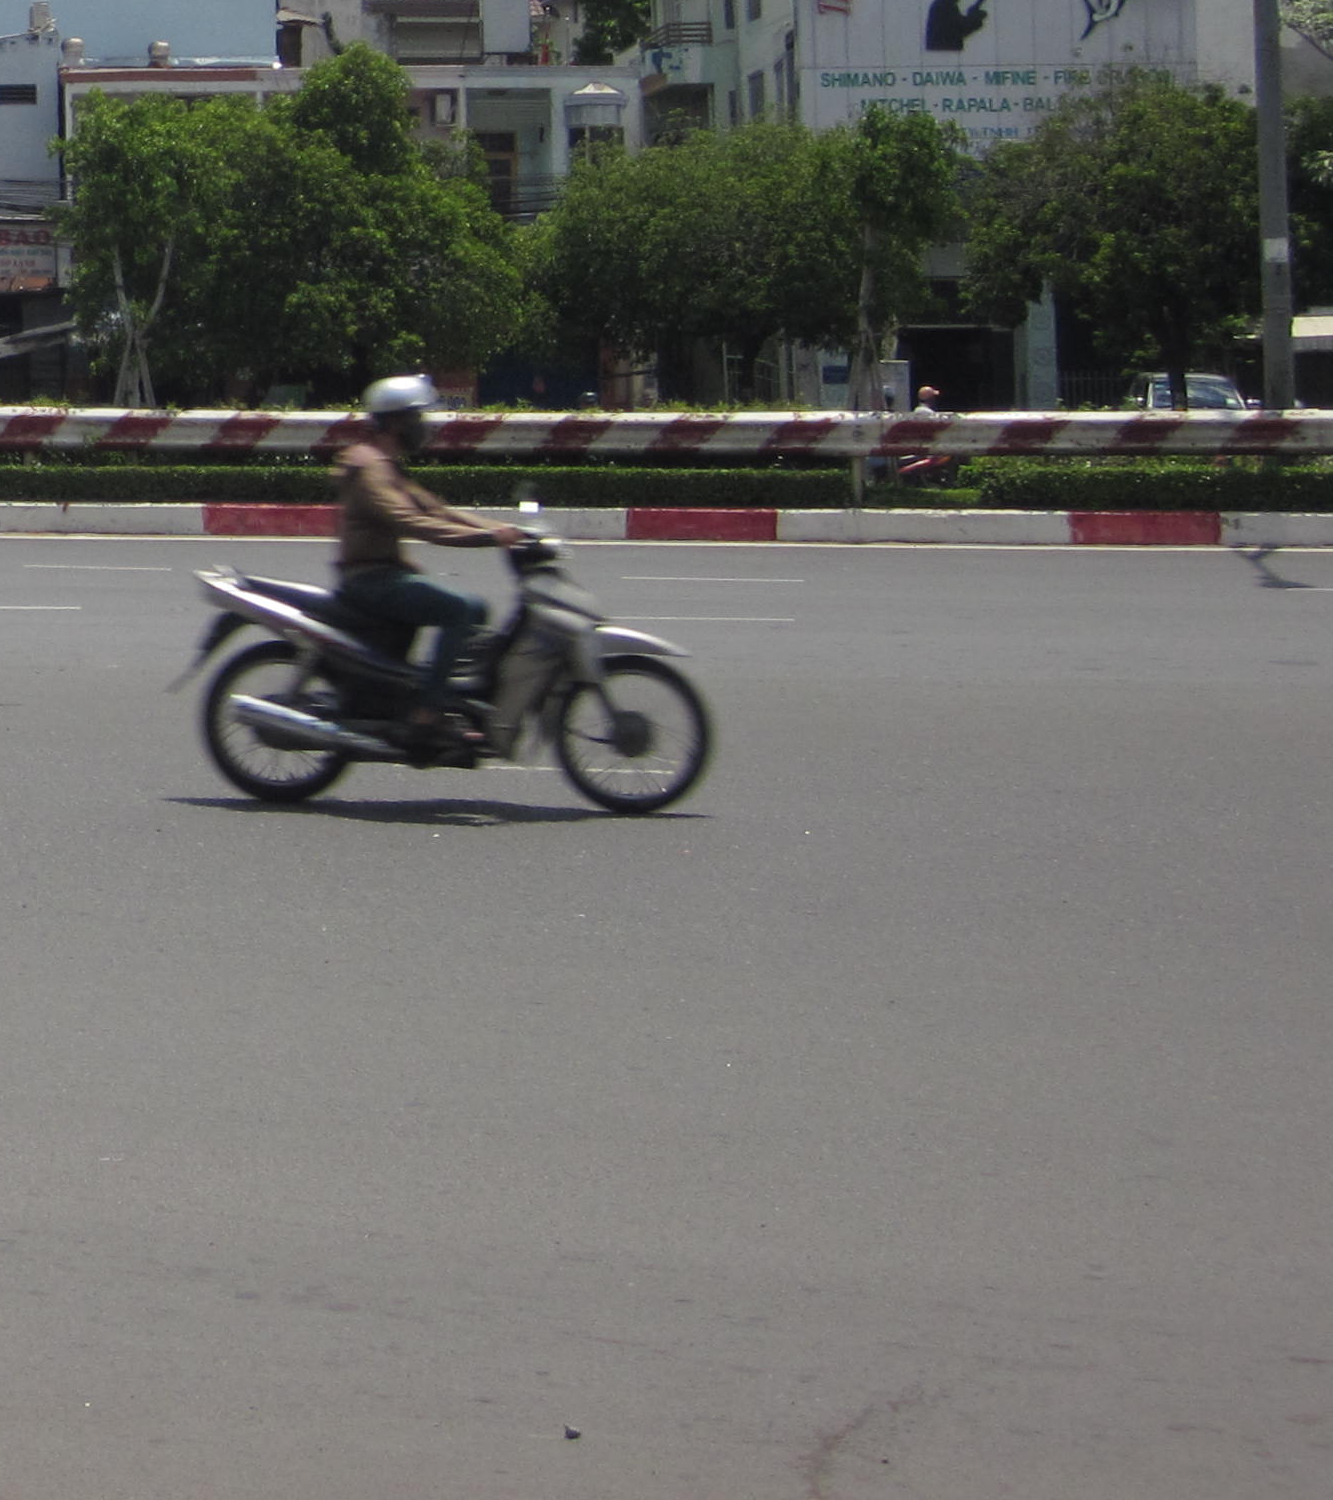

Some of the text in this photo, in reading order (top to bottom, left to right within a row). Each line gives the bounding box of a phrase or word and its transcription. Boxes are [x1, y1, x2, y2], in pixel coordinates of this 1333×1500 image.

[820, 72, 897, 88] SHIMANO
[911, 70, 967, 87] DAIWA
[941, 97, 1012, 113] RAPALA
